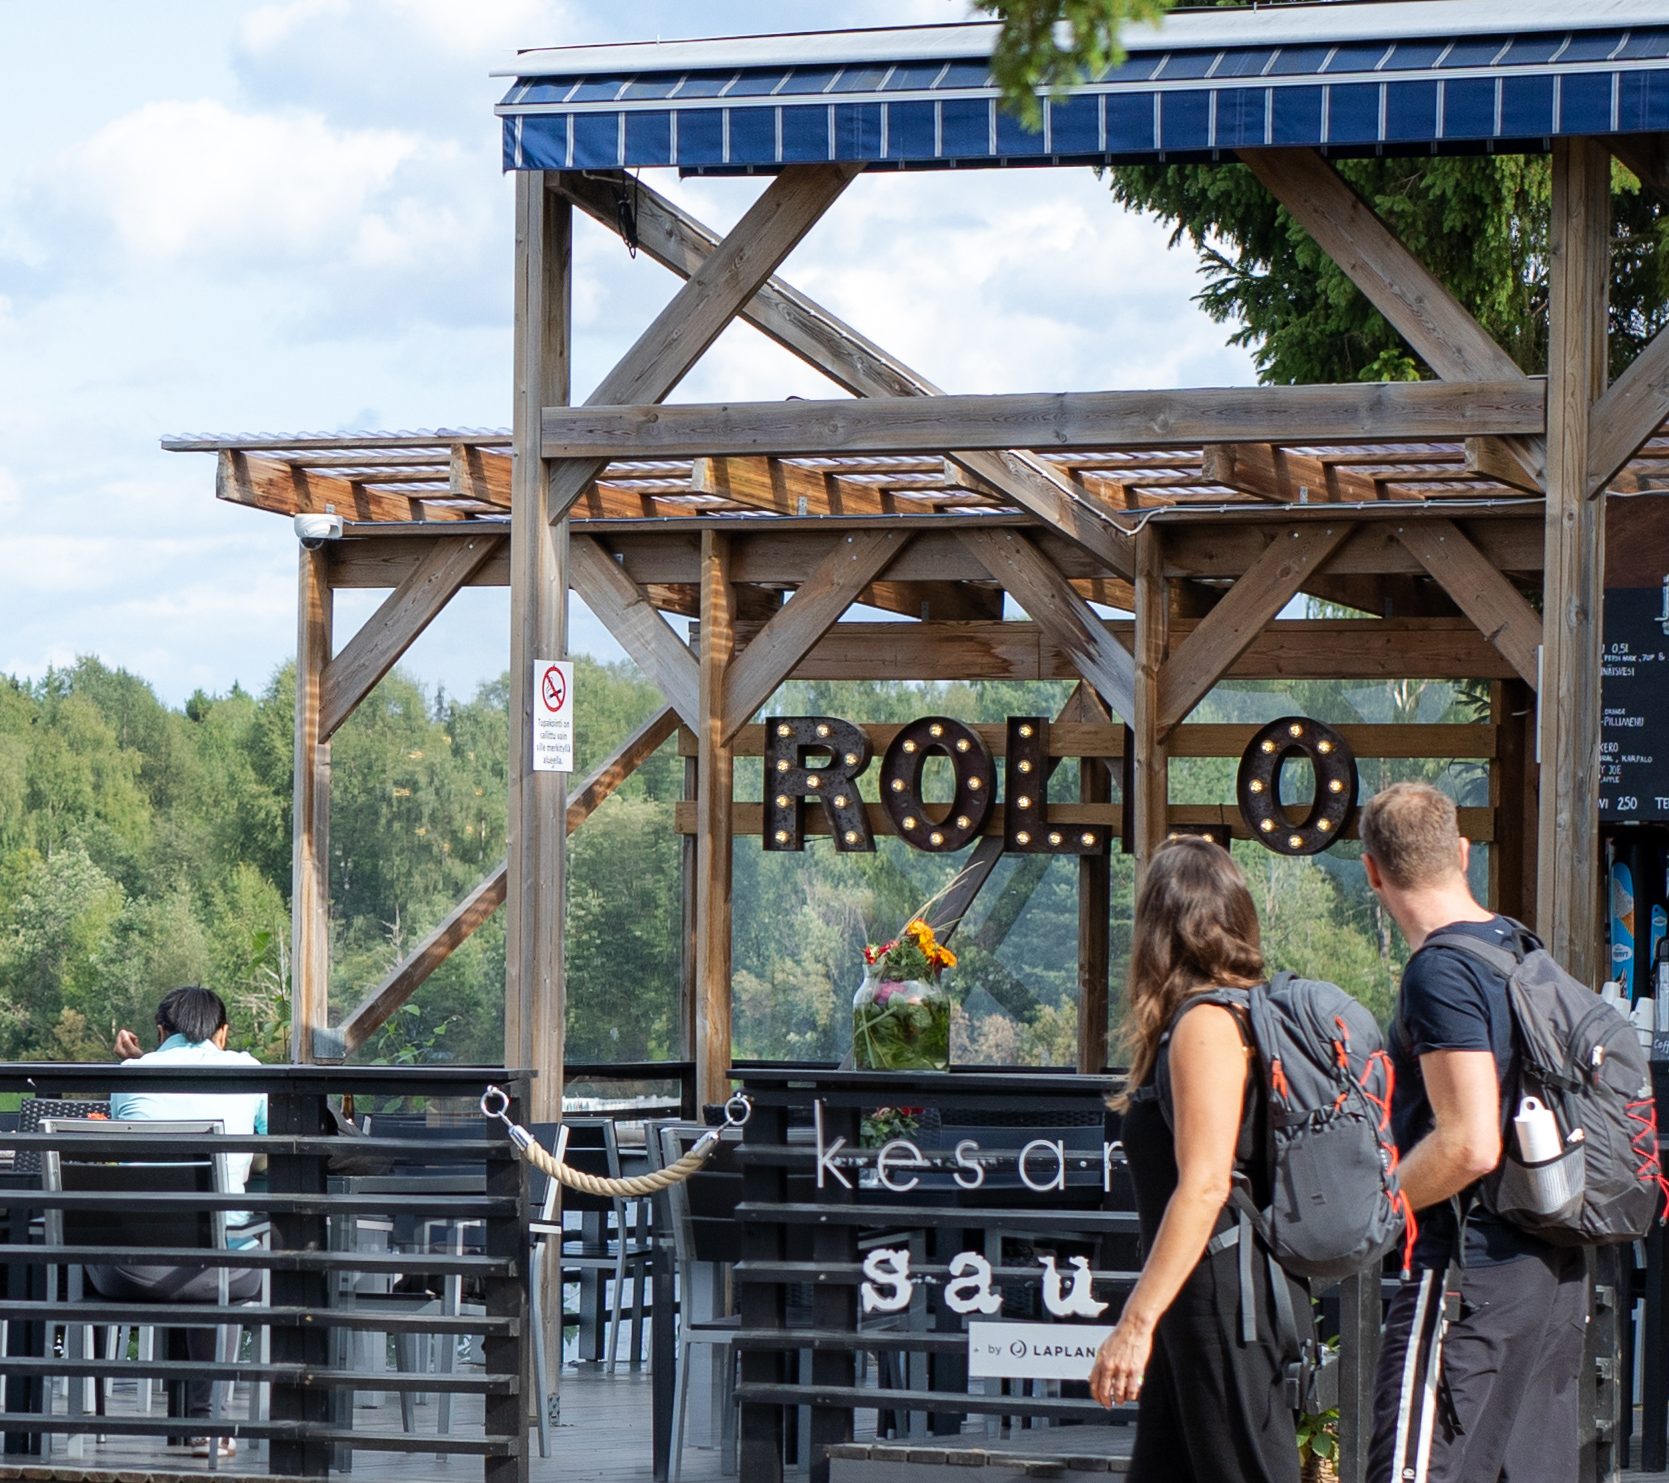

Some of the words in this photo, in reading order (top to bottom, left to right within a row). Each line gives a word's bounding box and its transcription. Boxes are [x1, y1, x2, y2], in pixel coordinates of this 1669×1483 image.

[1608, 765, 1622, 775] JOE
[763, 716, 1358, 856] ROLO
[988, 1344, 1002, 1356] by
[1033, 1345, 1097, 1358] LAPLAN
